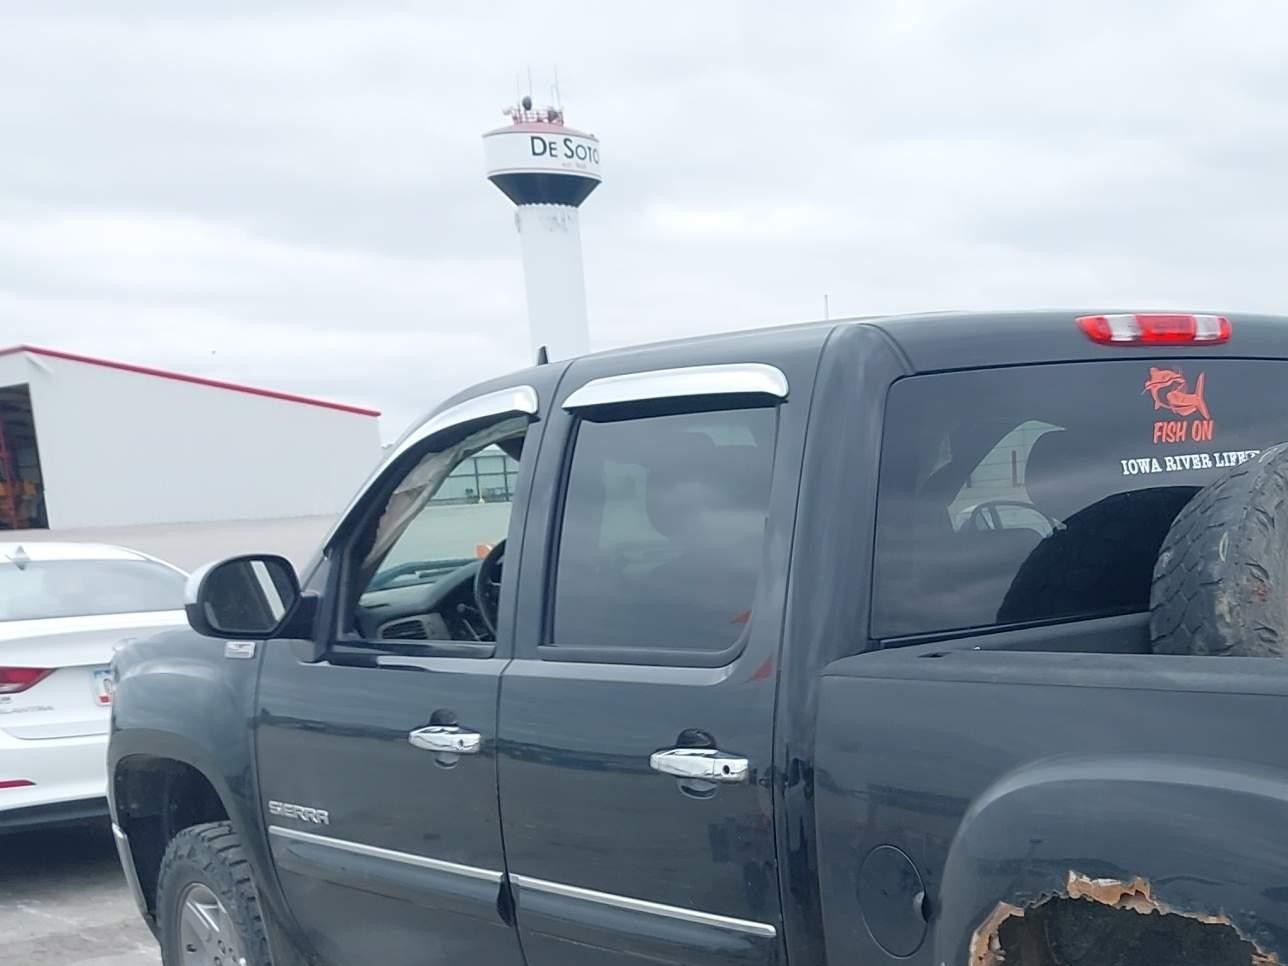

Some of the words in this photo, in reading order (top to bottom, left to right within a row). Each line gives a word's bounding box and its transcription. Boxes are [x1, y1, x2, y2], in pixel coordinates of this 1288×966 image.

[1153, 421, 1186, 444] FISH
[1191, 420, 1214, 442] ON
[1121, 457, 1162, 475] IOWA
[1165, 453, 1213, 472] RIVER
[268, 800, 329, 825] SIERRA
